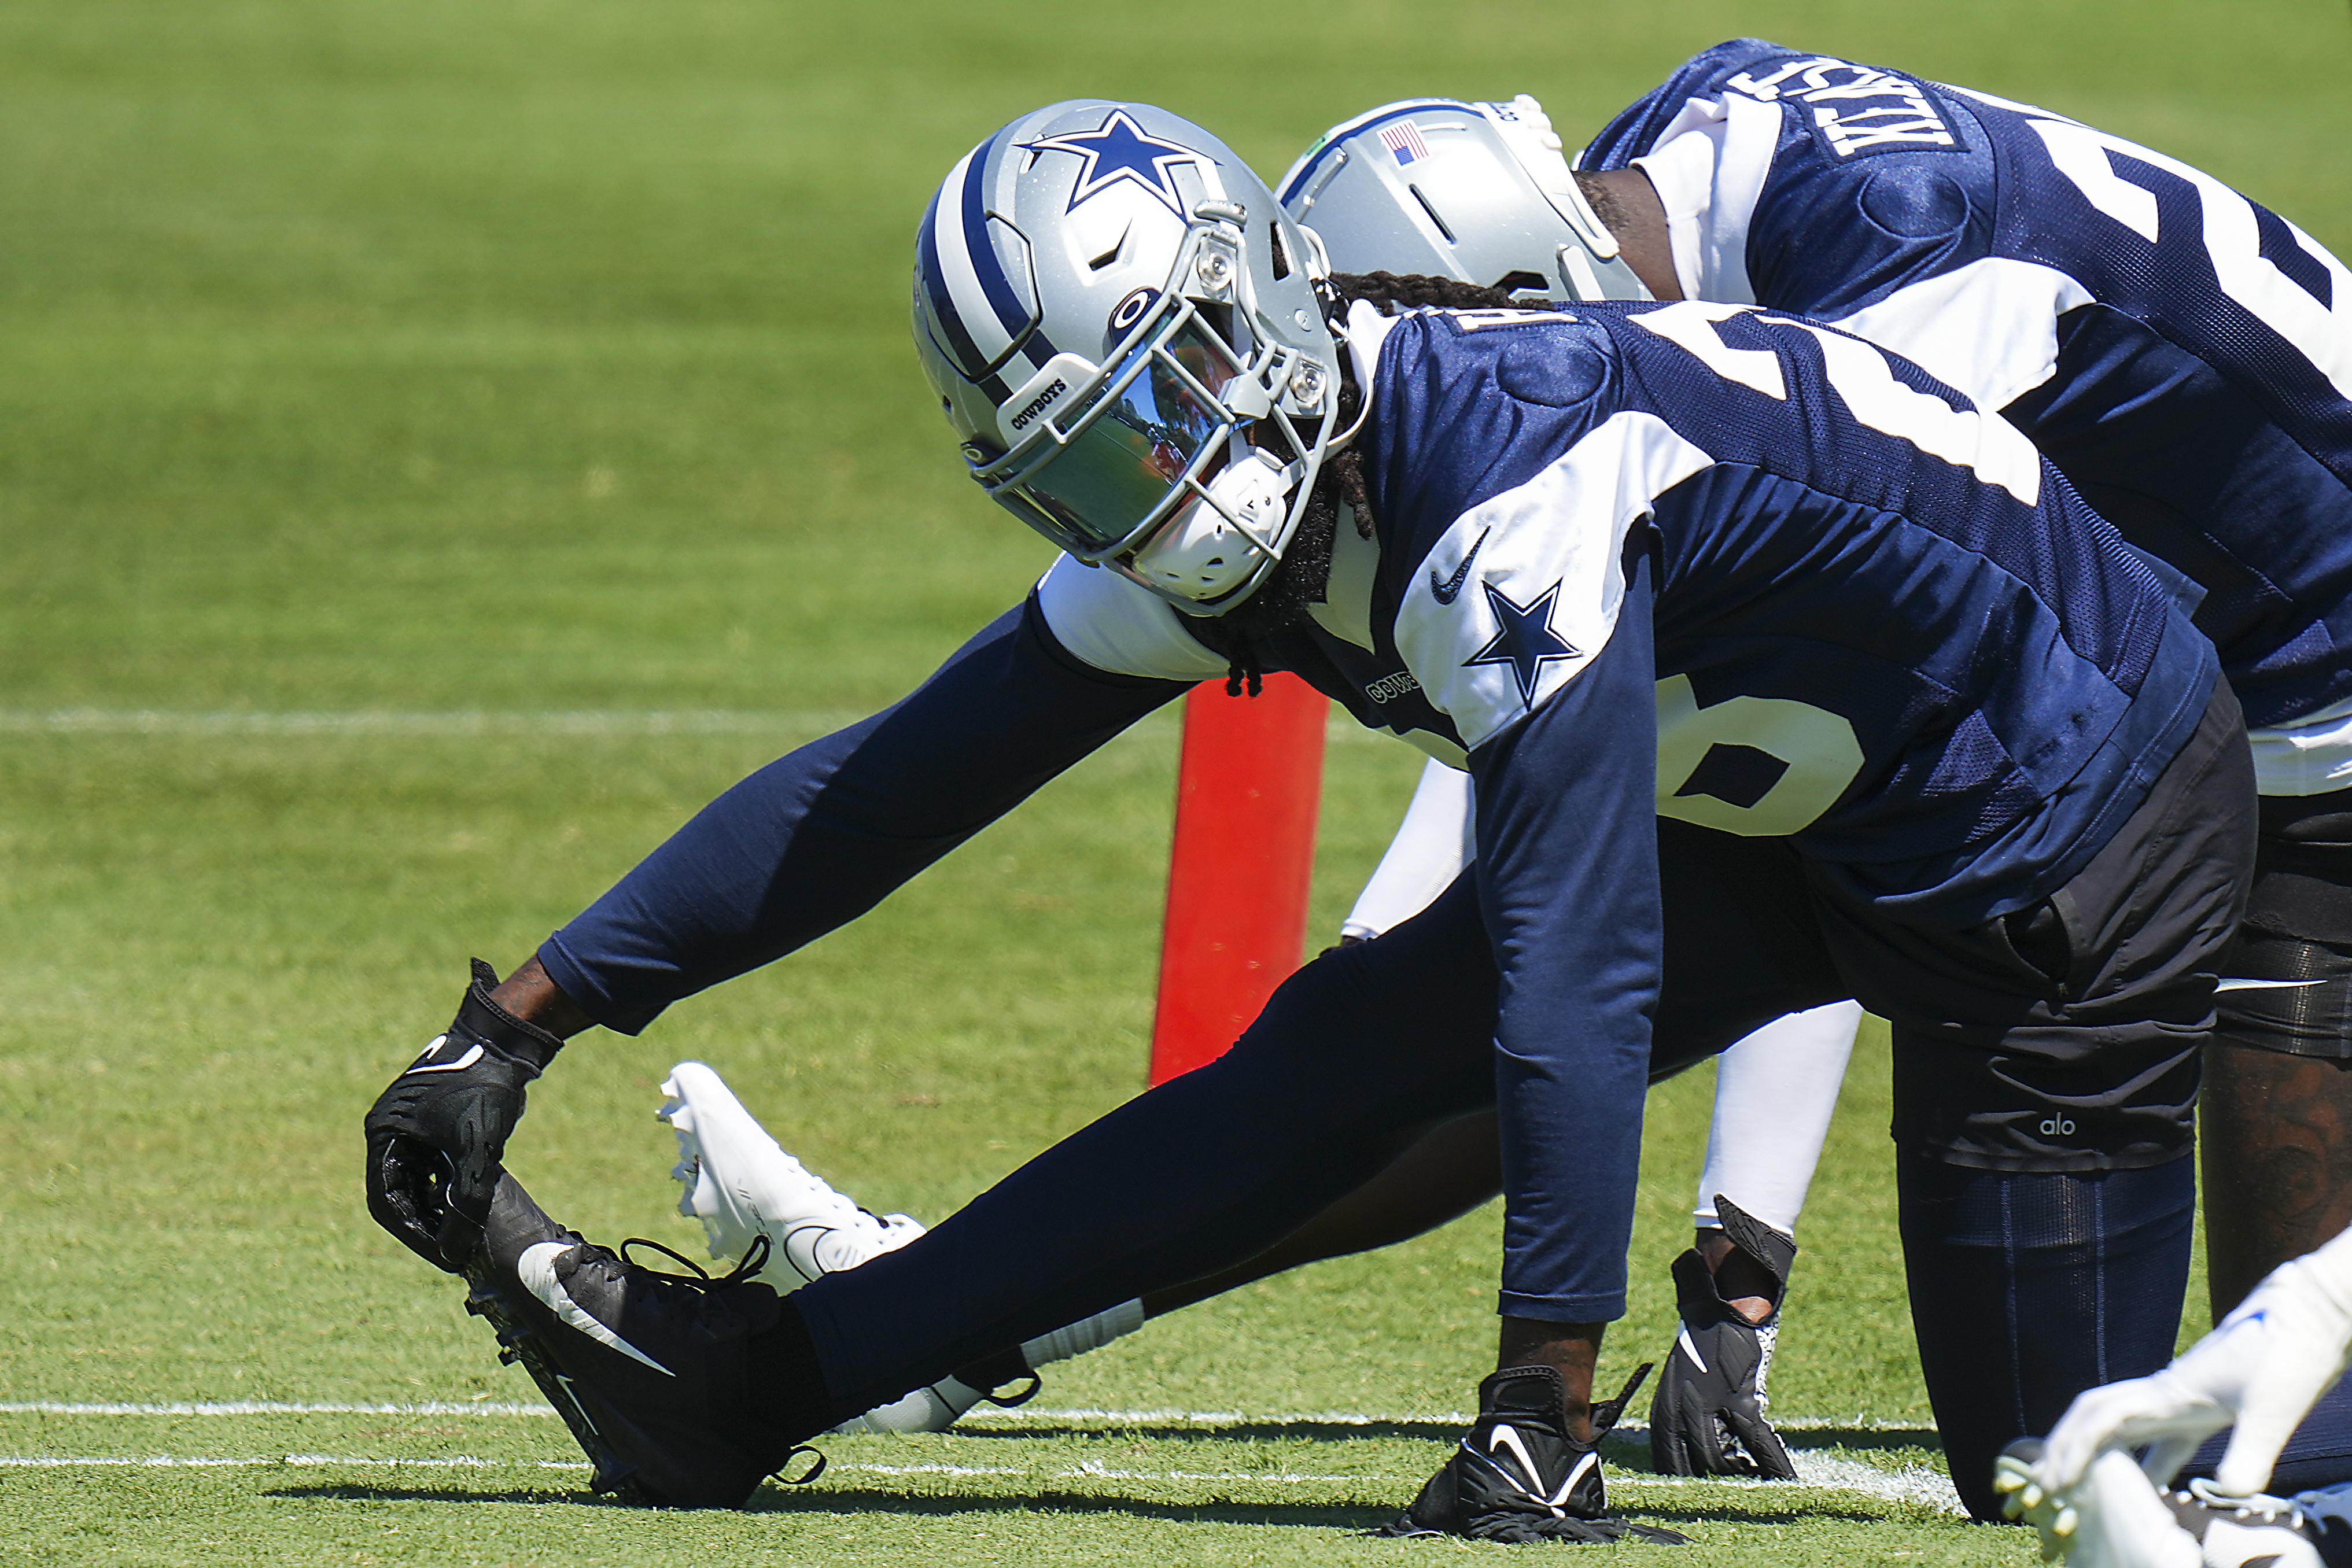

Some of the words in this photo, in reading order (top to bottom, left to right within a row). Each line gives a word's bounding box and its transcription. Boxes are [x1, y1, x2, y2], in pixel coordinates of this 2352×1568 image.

[1727, 57, 1954, 156] KEASE
[1011, 378, 1067, 430] COWBOYS
[2039, 1112, 2076, 1135] alo
